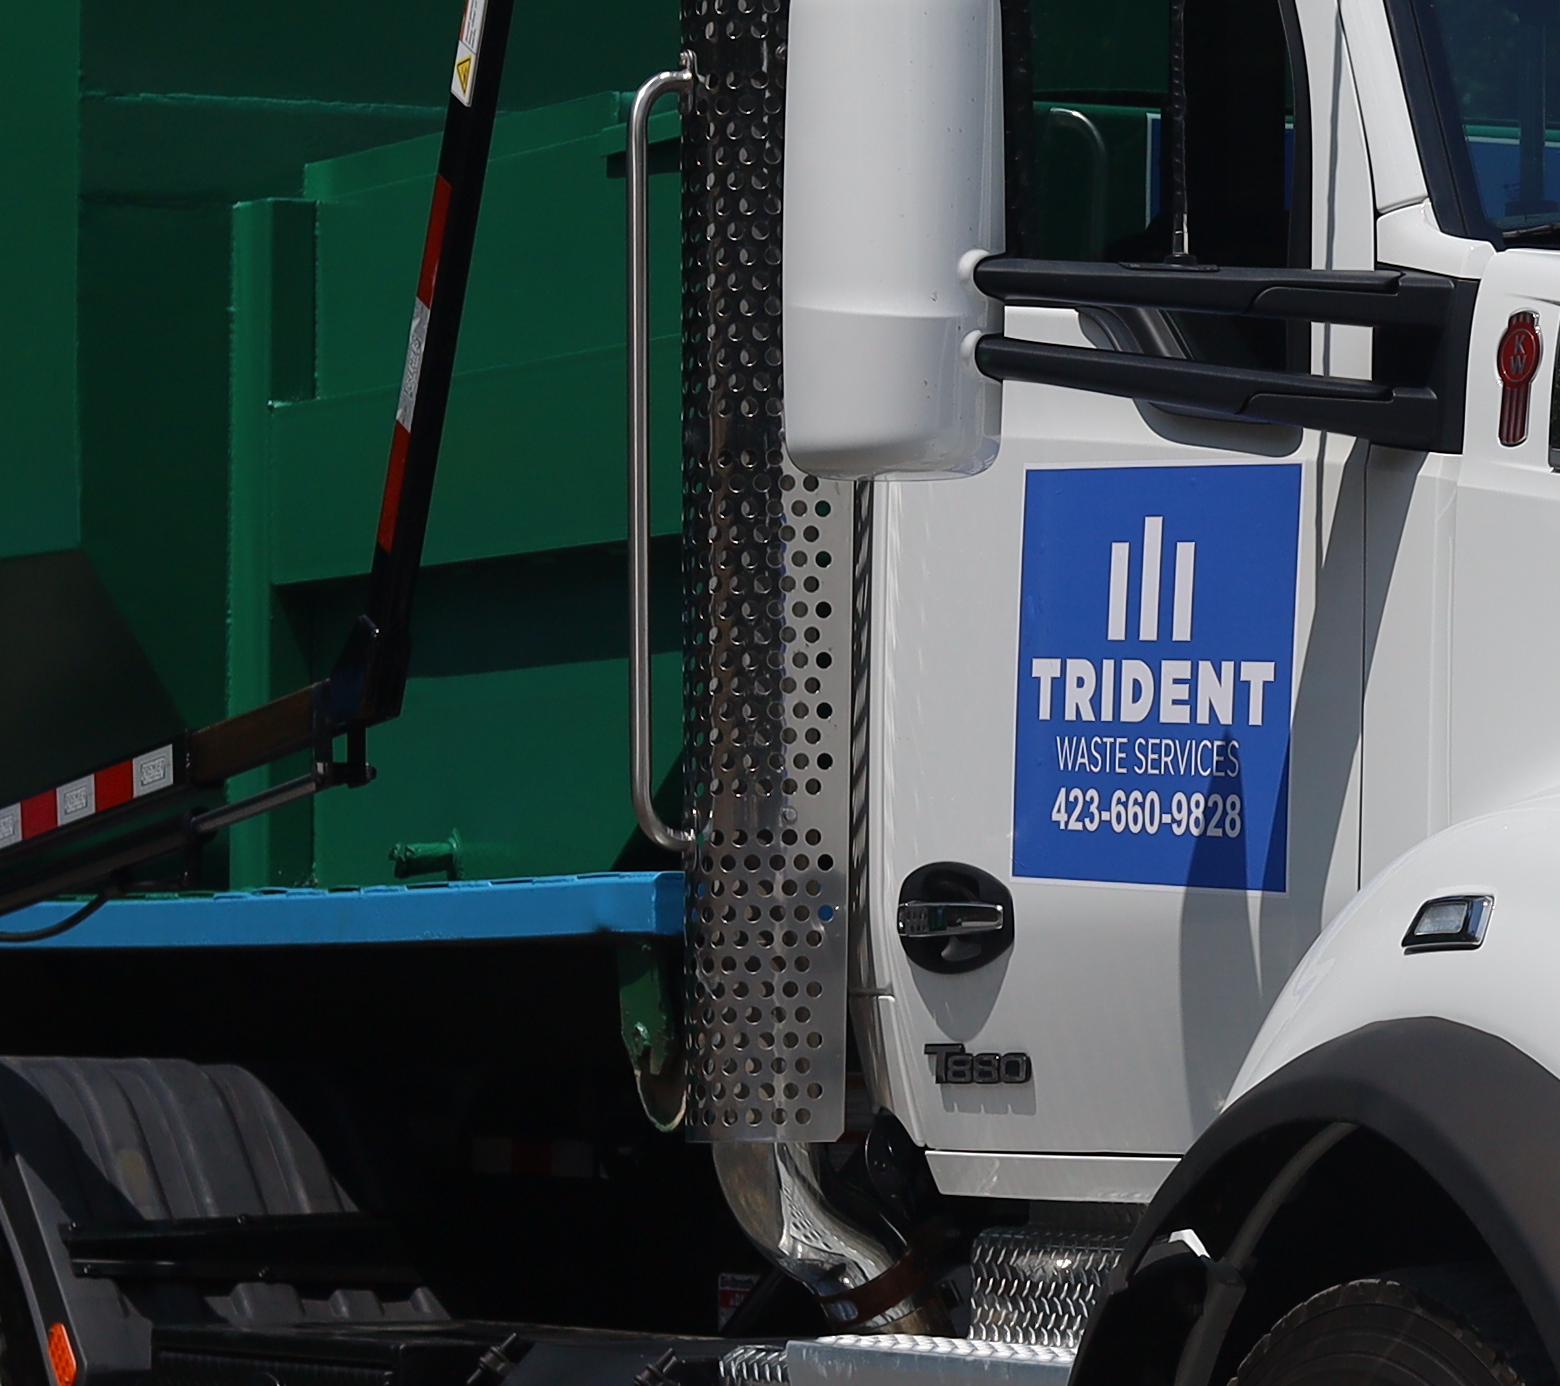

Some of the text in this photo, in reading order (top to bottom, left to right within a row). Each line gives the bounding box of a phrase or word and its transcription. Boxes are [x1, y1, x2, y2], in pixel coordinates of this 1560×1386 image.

[1032, 658, 1275, 726] TRIDENT
[1056, 736, 1240, 778] WASTE SERVICES
[1051, 788, 1242, 839] 423-660-9828
[924, 1043, 1032, 1084] T880
